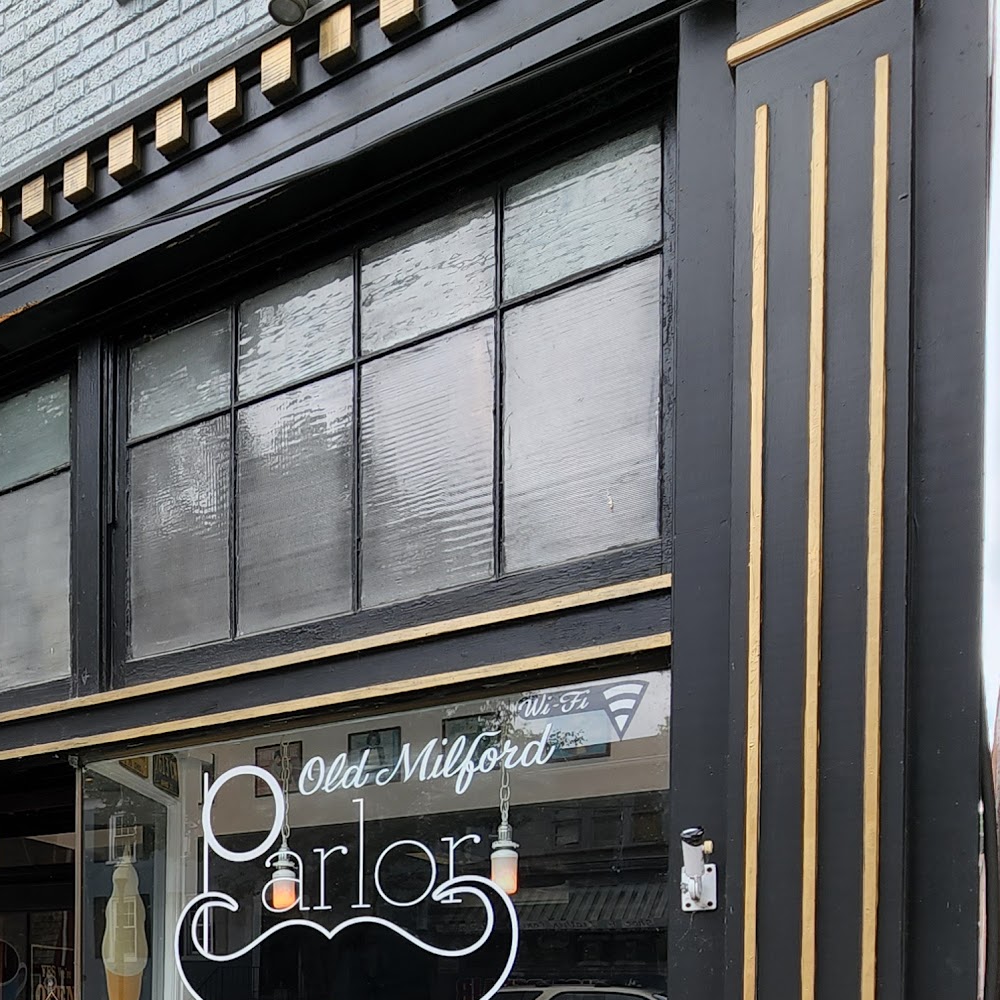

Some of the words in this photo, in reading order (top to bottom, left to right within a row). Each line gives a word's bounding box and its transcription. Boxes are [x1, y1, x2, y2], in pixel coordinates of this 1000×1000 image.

[518, 690, 590, 718] Wi-Fi
[298, 756, 371, 796] Old
[375, 723, 557, 795] Milford
[202, 764, 481, 954] Parlor
